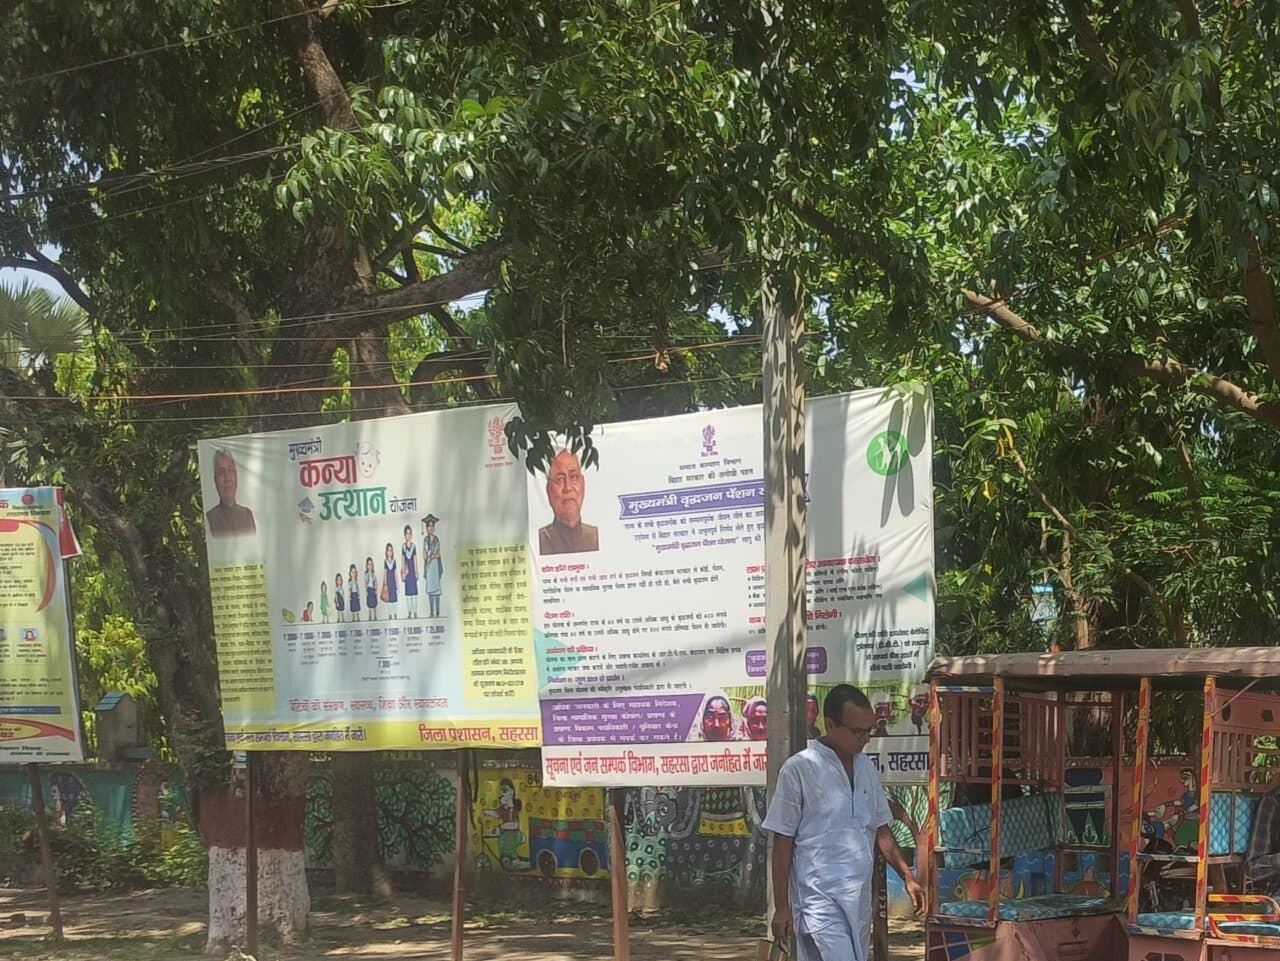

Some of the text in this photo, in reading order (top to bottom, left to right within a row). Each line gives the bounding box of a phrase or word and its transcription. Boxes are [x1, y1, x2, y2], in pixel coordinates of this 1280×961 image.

[288, 436, 322, 461] मुख्यमंत्री
[299, 455, 357, 488] कन्या
[318, 487, 417, 521] उत्थान योजना
[627, 493, 678, 514] मुख्यमंत्री
[418, 722, 538, 744] जिला प्रशासन, सहरसा
[545, 756, 570, 781] सूचना
[570, 751, 583, 777] एवं
[583, 756, 599, 775] जन
[599, 750, 628, 775] सम्पर्क
[627, 750, 660, 776] विभाग,
[660, 754, 690, 773] सहरसा
[690, 754, 709, 775] द्वारा
[709, 748, 742, 773] जनहित
[887, 751, 930, 772] सहरसा
